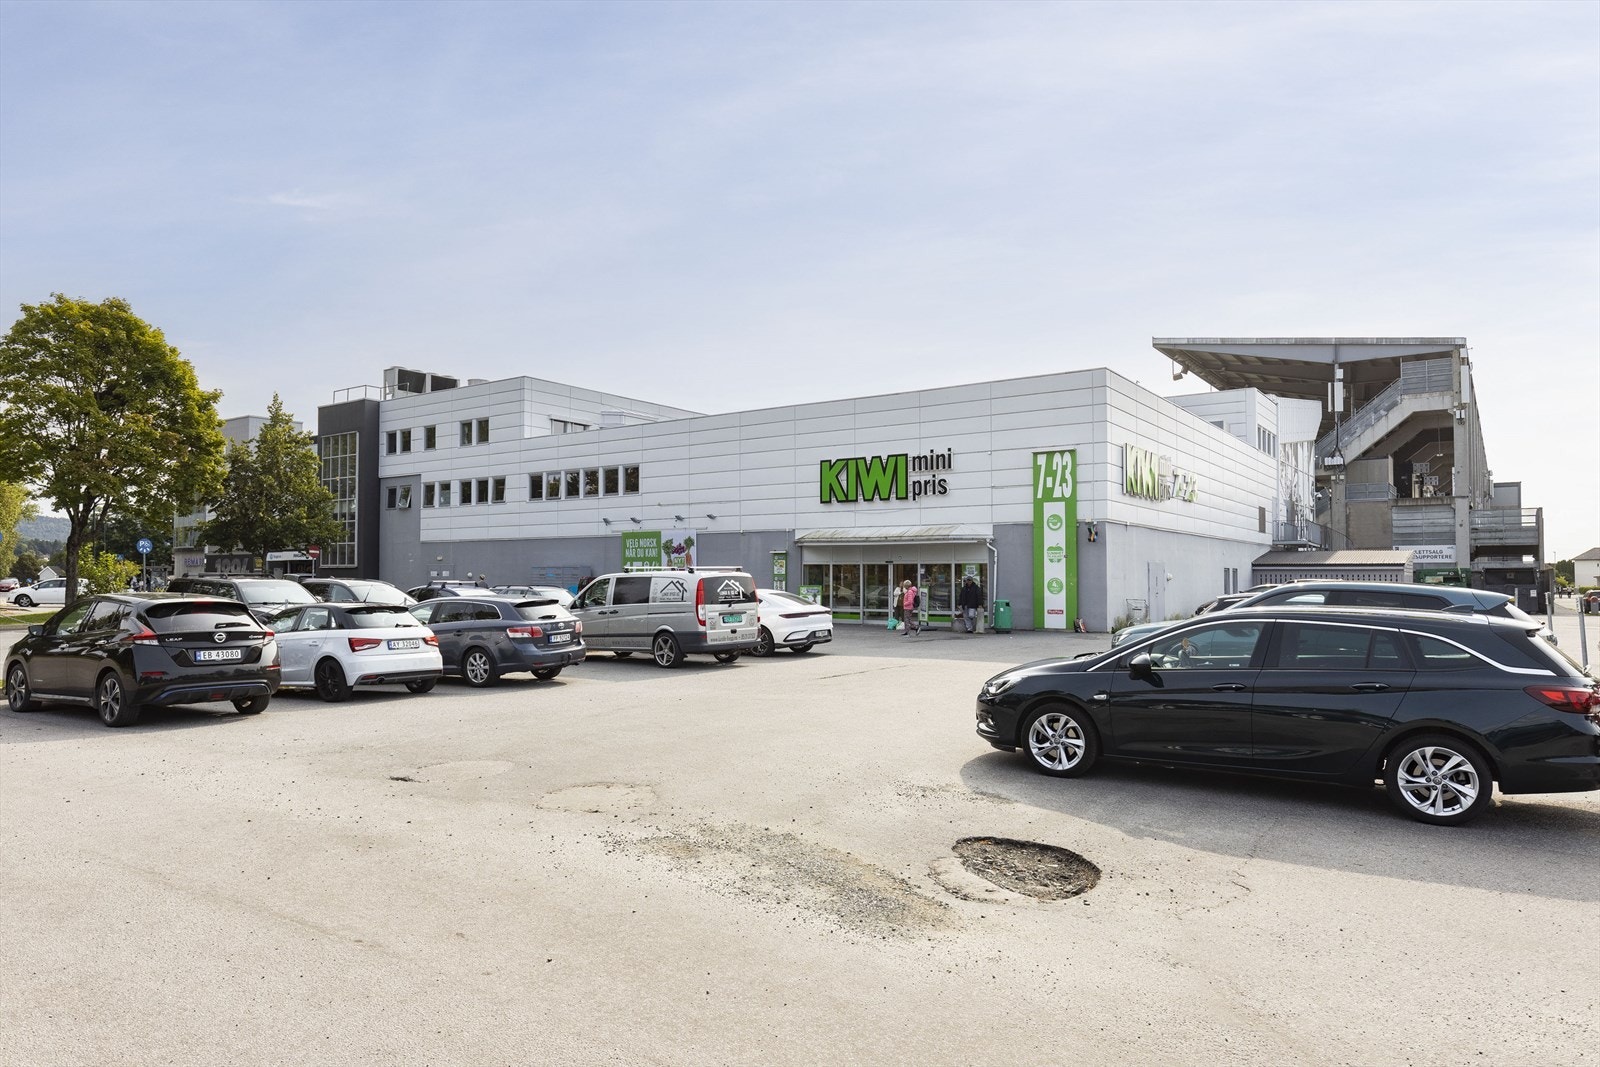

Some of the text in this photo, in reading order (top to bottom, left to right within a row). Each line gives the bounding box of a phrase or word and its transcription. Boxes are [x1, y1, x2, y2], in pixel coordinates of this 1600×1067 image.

[820, 448, 952, 504] KIWI mini
[1036, 451, 1073, 499] 7-23
[1122, 443, 1160, 502] KIWI
[912, 474, 948, 501] pris
[625, 547, 658, 558] NÅR DU KAN!
[626, 538, 657, 548] VELG NORSK
[203, 650, 239, 660] EB 43080
